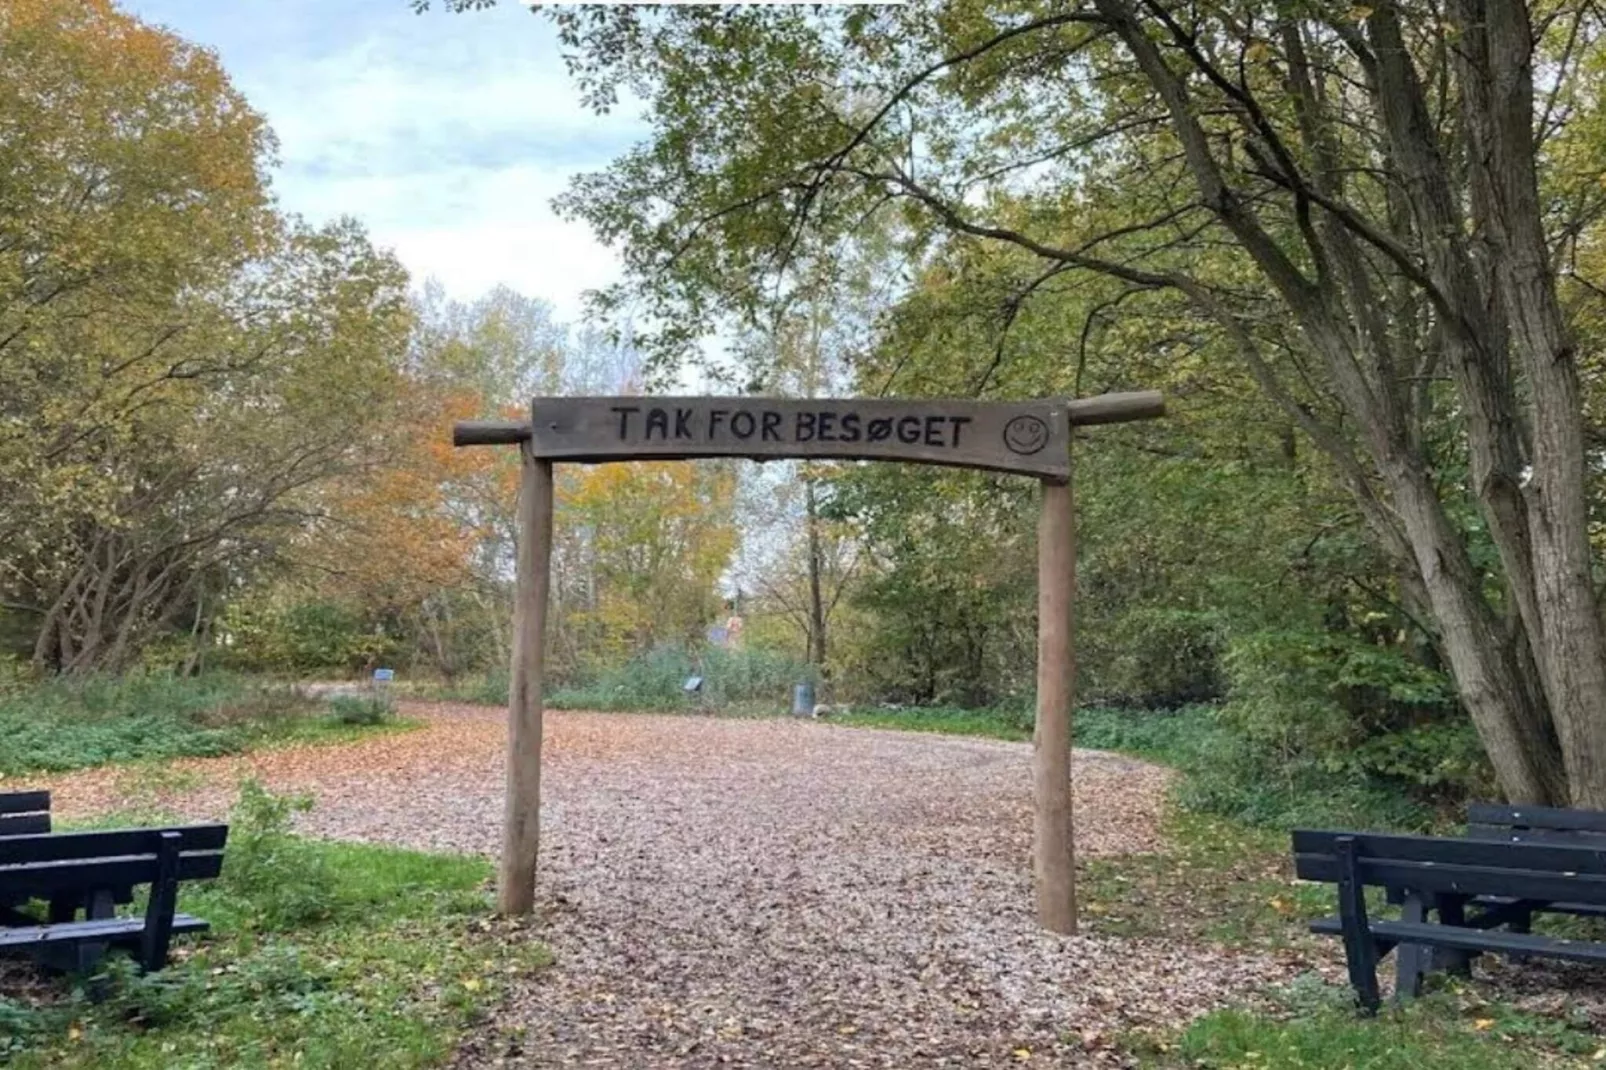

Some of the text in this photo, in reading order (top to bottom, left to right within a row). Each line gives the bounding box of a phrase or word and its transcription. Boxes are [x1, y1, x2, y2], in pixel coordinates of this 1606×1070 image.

[611, 407, 971, 449] TAK FOR BESØGET
